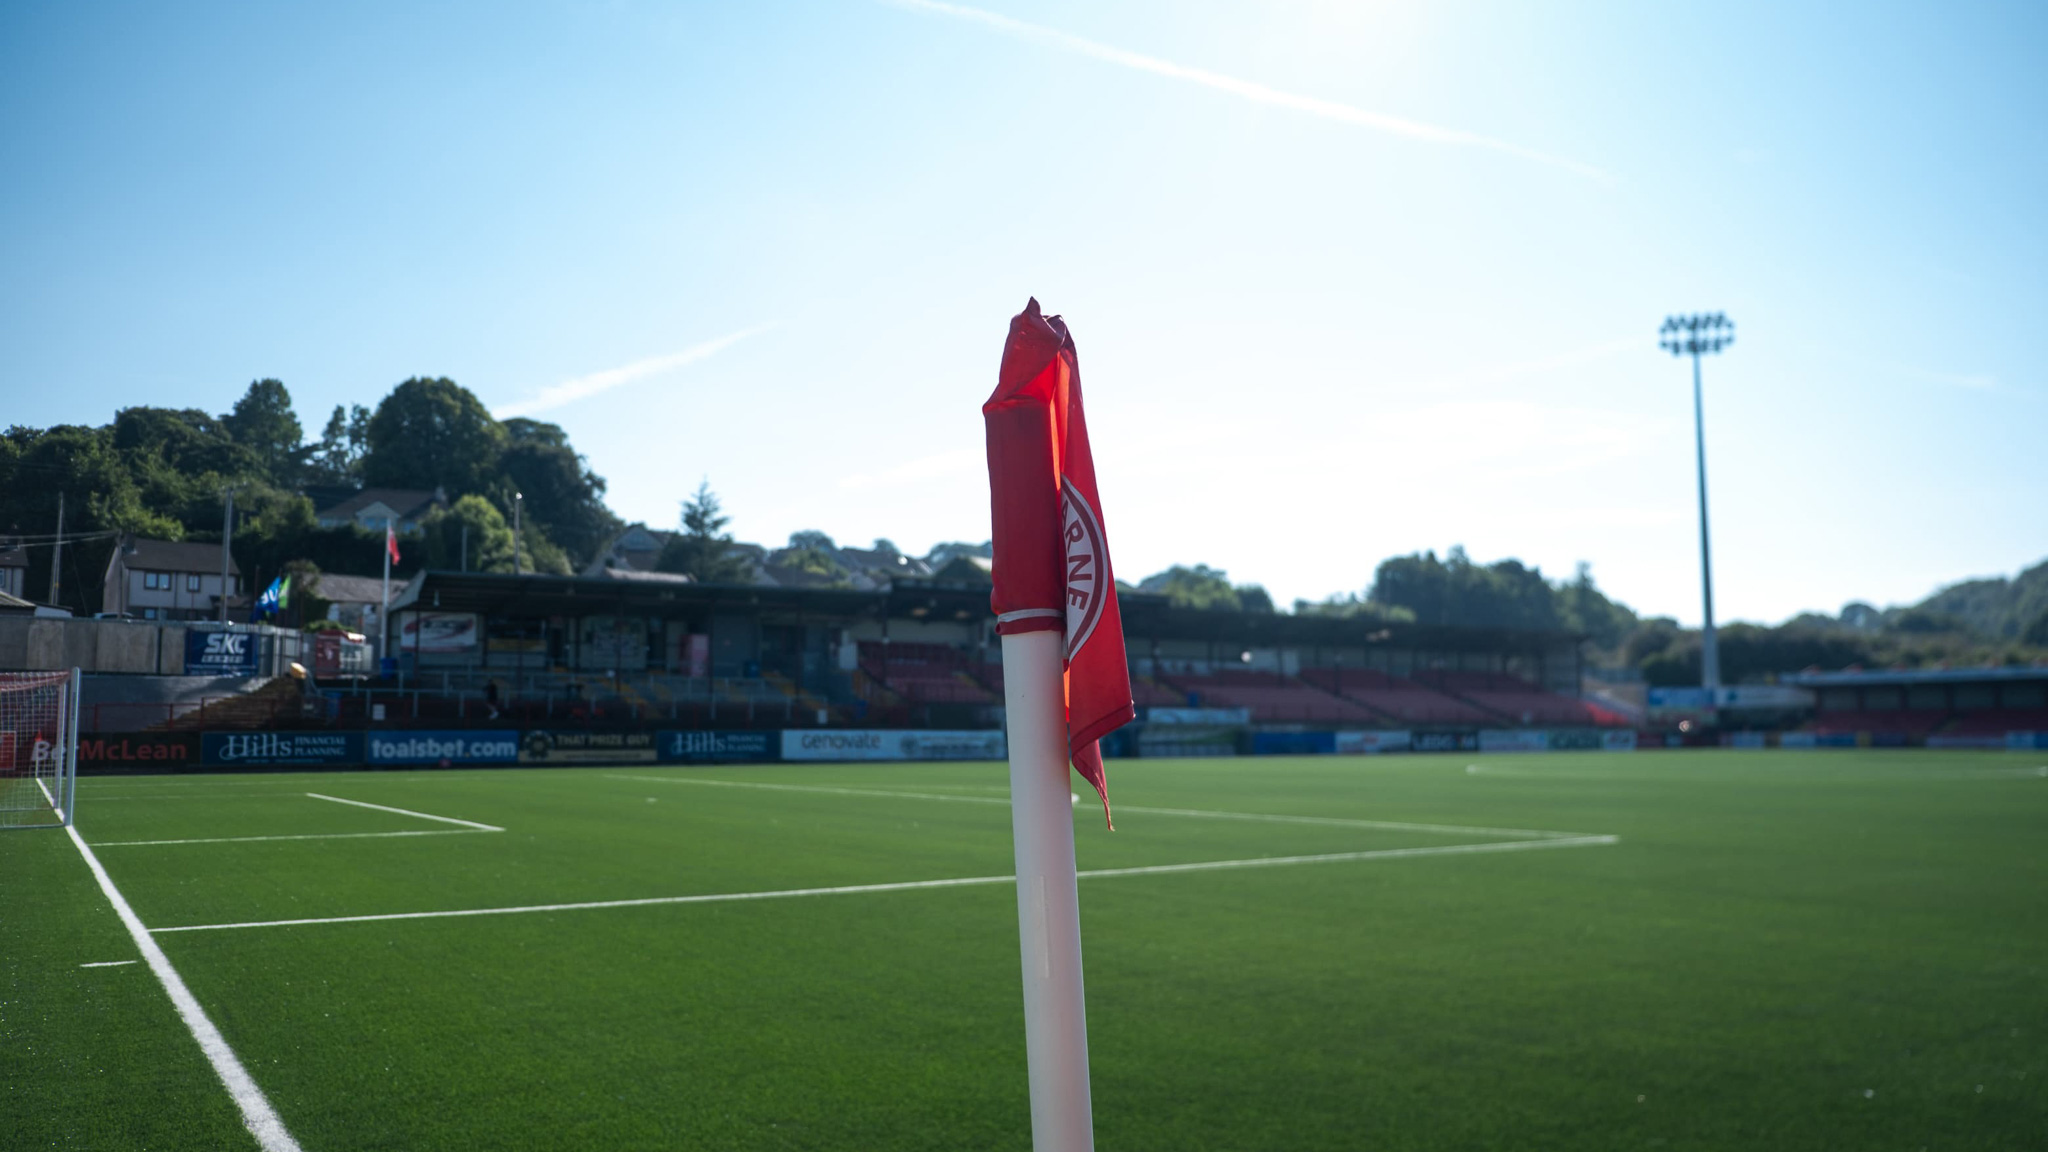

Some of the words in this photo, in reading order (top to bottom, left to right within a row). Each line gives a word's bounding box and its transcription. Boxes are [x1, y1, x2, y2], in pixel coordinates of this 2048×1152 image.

[204, 633, 248, 654] SKC
[219, 733, 292, 760] Hills
[295, 736, 346, 746] FINANCIAL
[371, 738, 517, 758] toalsbet.com
[670, 731, 726, 755] Hills
[295, 747, 345, 756] PLANNING
